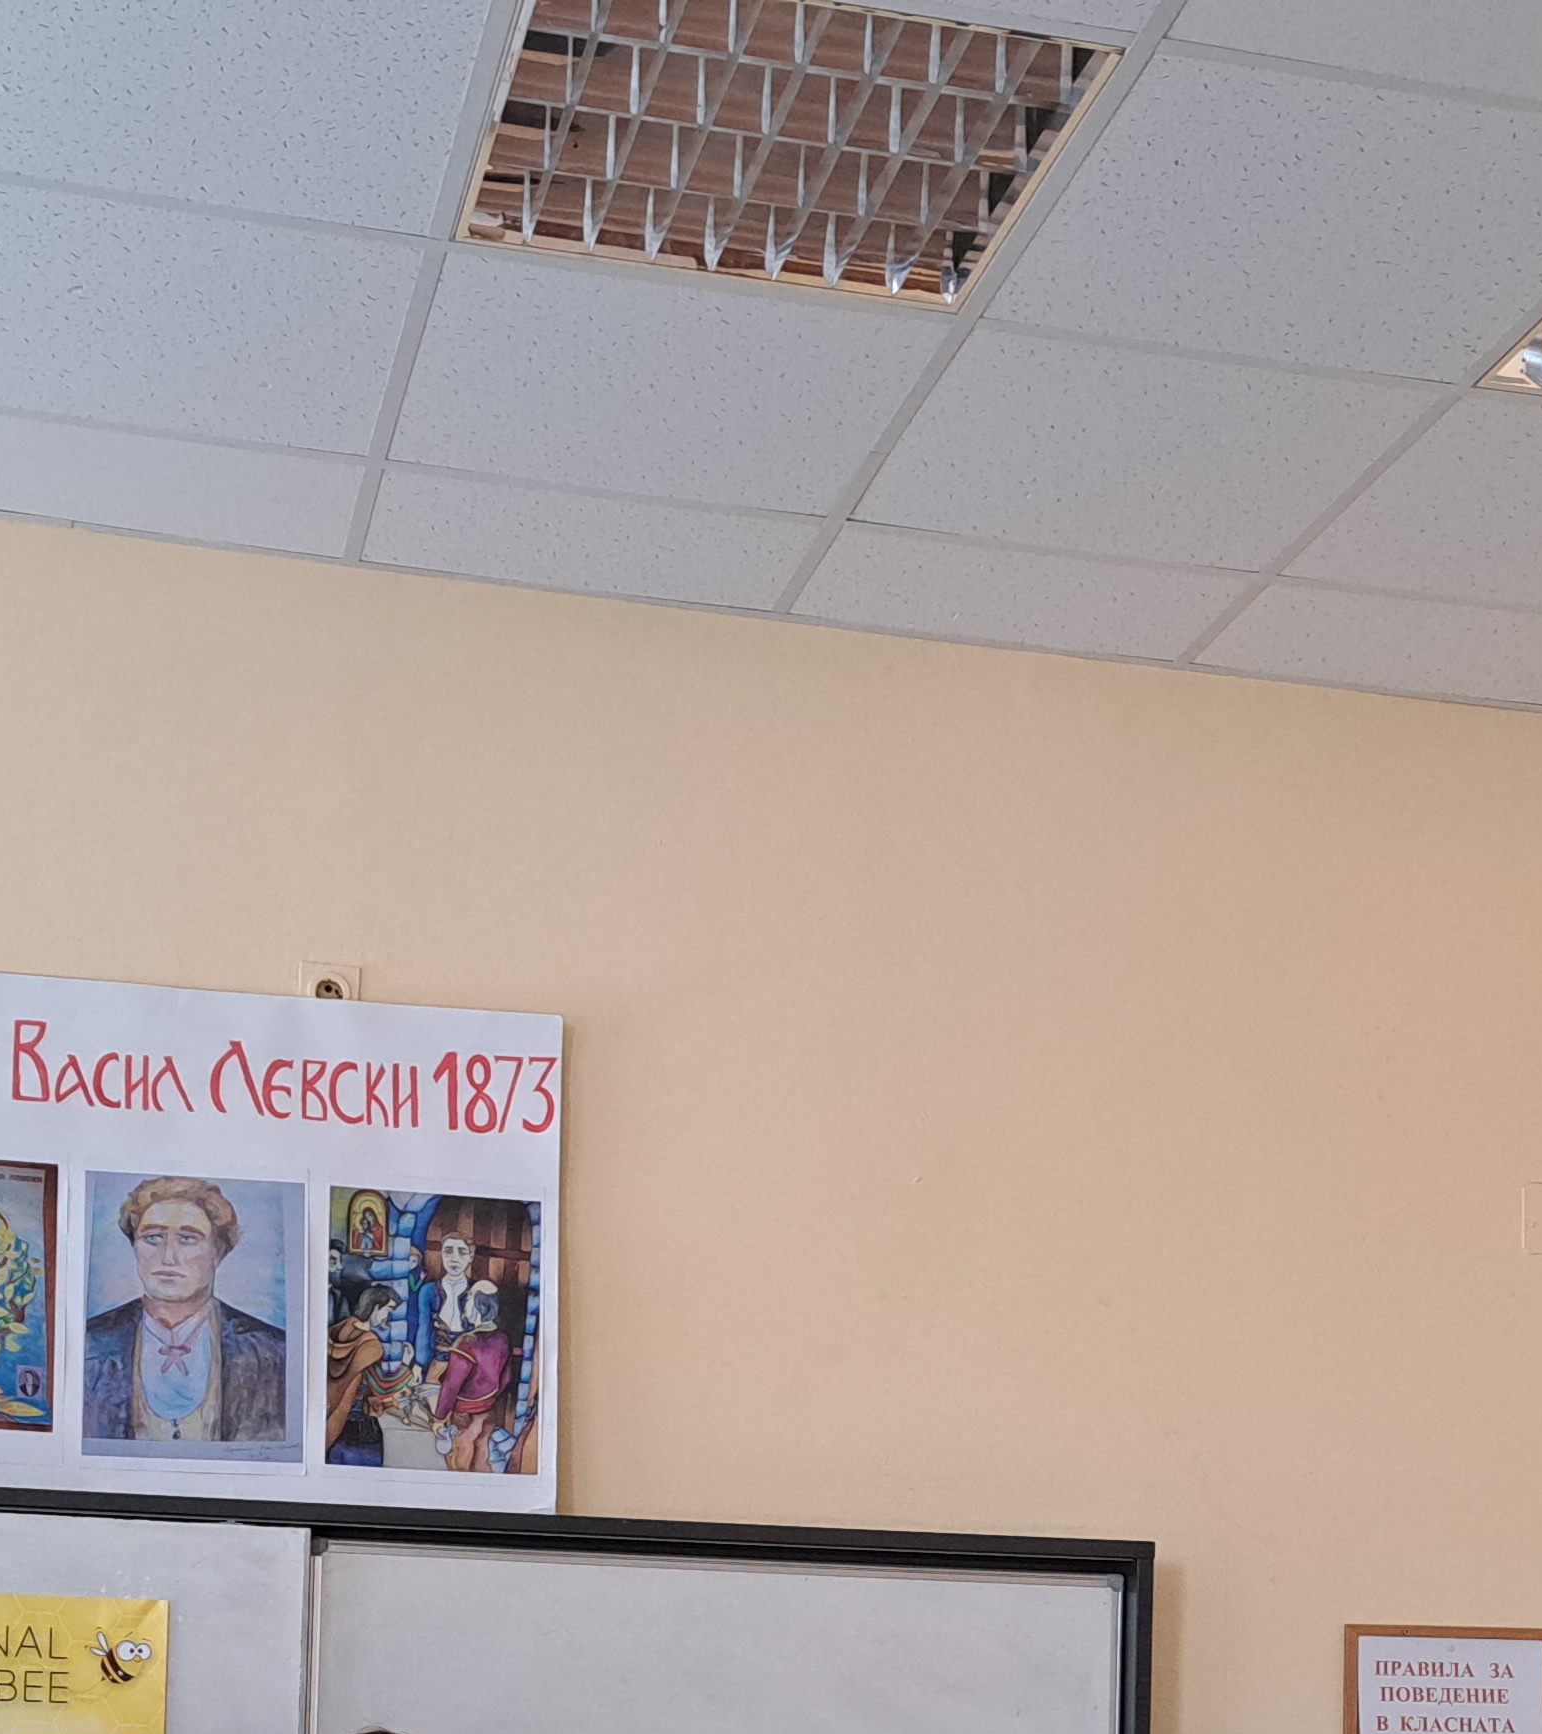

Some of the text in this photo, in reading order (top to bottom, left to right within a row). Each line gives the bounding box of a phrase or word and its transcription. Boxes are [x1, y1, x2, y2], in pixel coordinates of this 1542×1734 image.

[431, 1050, 559, 1134] 1873
[1374, 1660, 1514, 1679] ПРАВИЛА ЗА
[1380, 1686, 1509, 1705] ПОВЕДЕНИЕ
[1376, 1715, 1516, 1734] В КЛАСНАТА
